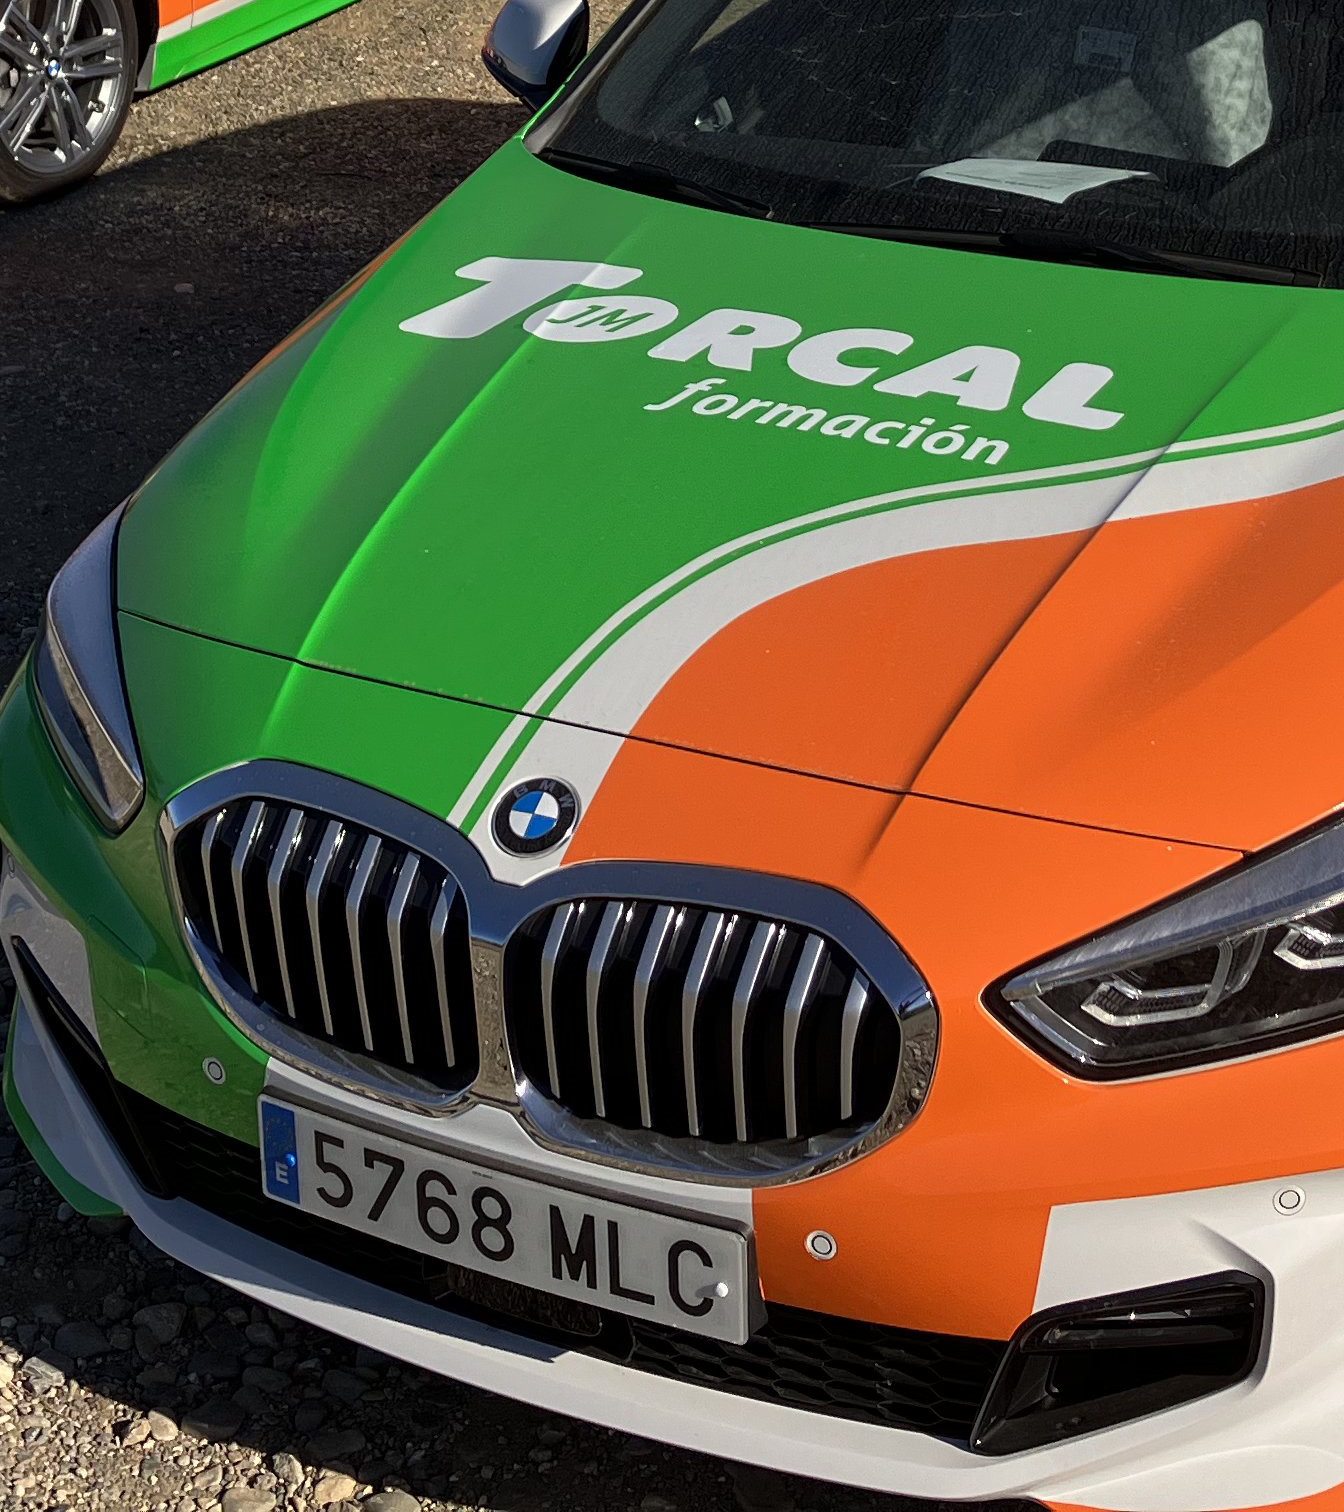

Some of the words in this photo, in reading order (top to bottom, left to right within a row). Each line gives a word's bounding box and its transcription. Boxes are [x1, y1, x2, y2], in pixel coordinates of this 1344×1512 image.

[398, 255, 1126, 430] TORCAL
[643, 378, 1010, 465] formación
[513, 779, 574, 808] BMW
[275, 1160, 290, 1185] E
[314, 1130, 515, 1262] 5768
[549, 1204, 715, 1317] MLC
